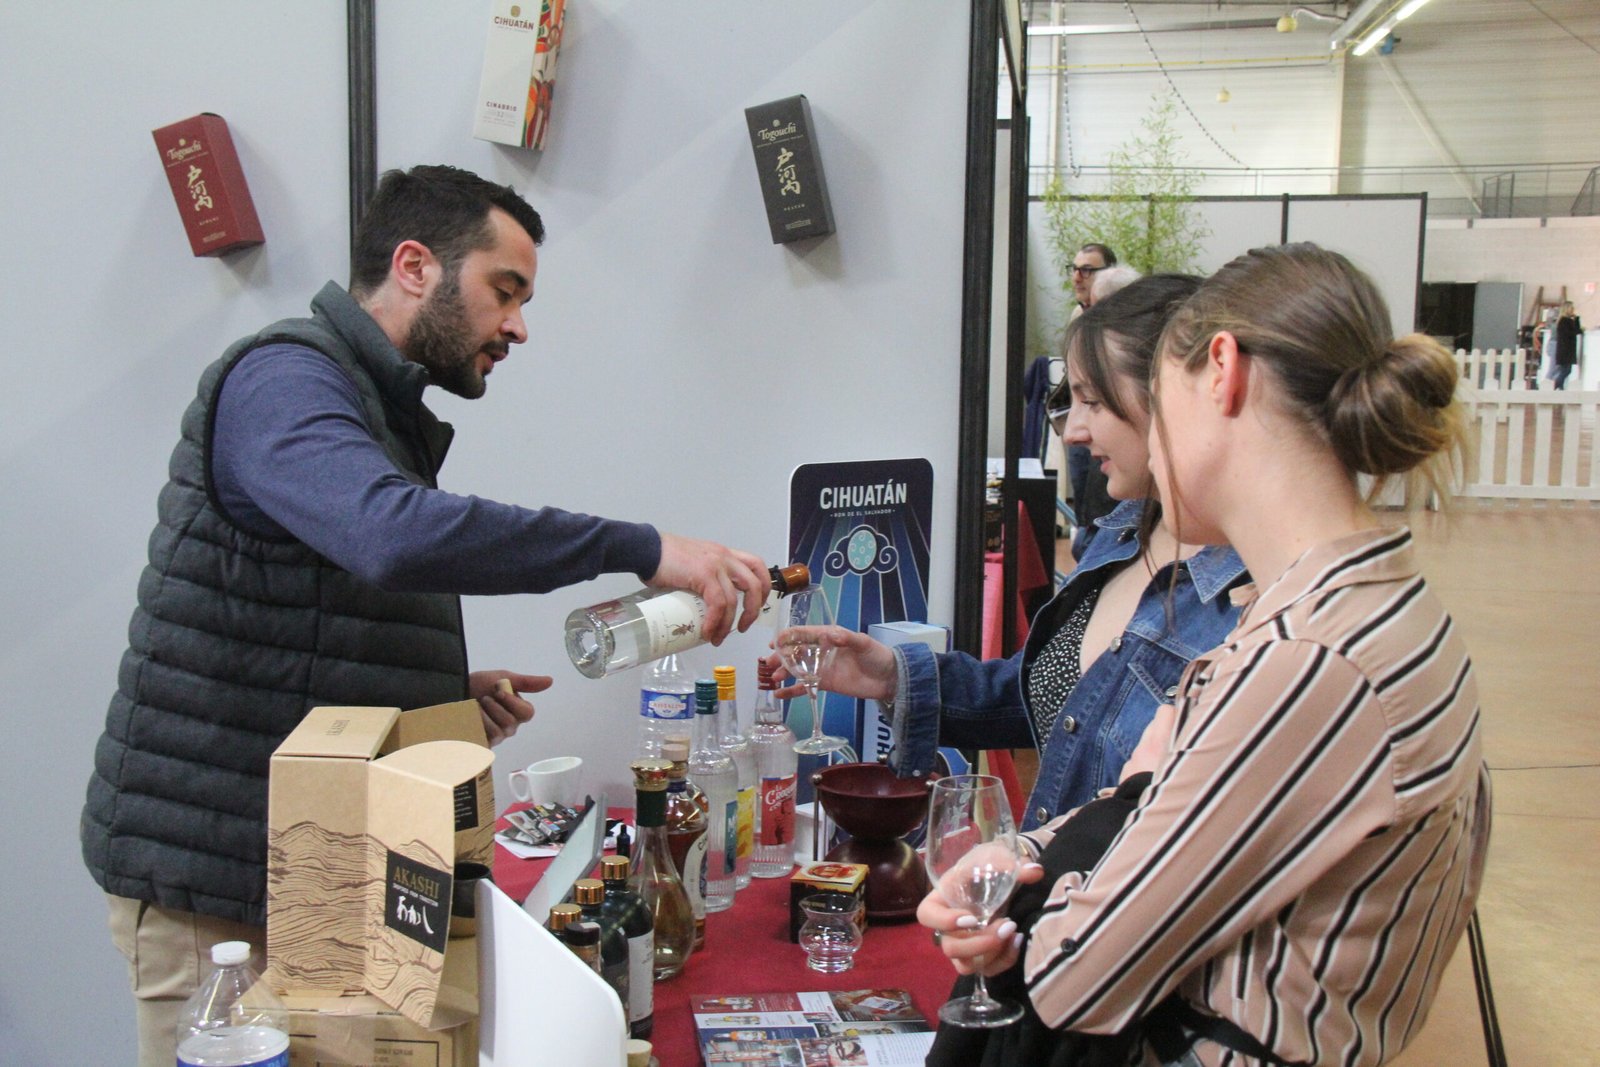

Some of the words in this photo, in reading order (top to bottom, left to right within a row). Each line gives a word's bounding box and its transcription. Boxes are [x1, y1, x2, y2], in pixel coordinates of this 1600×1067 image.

[494, 16, 534, 30] CIHUATÁN
[757, 122, 797, 141] Togouchi
[166, 139, 202, 160] Togouchi
[820, 479, 907, 509] CIHUATÁN
[393, 866, 440, 899] AKASHI
